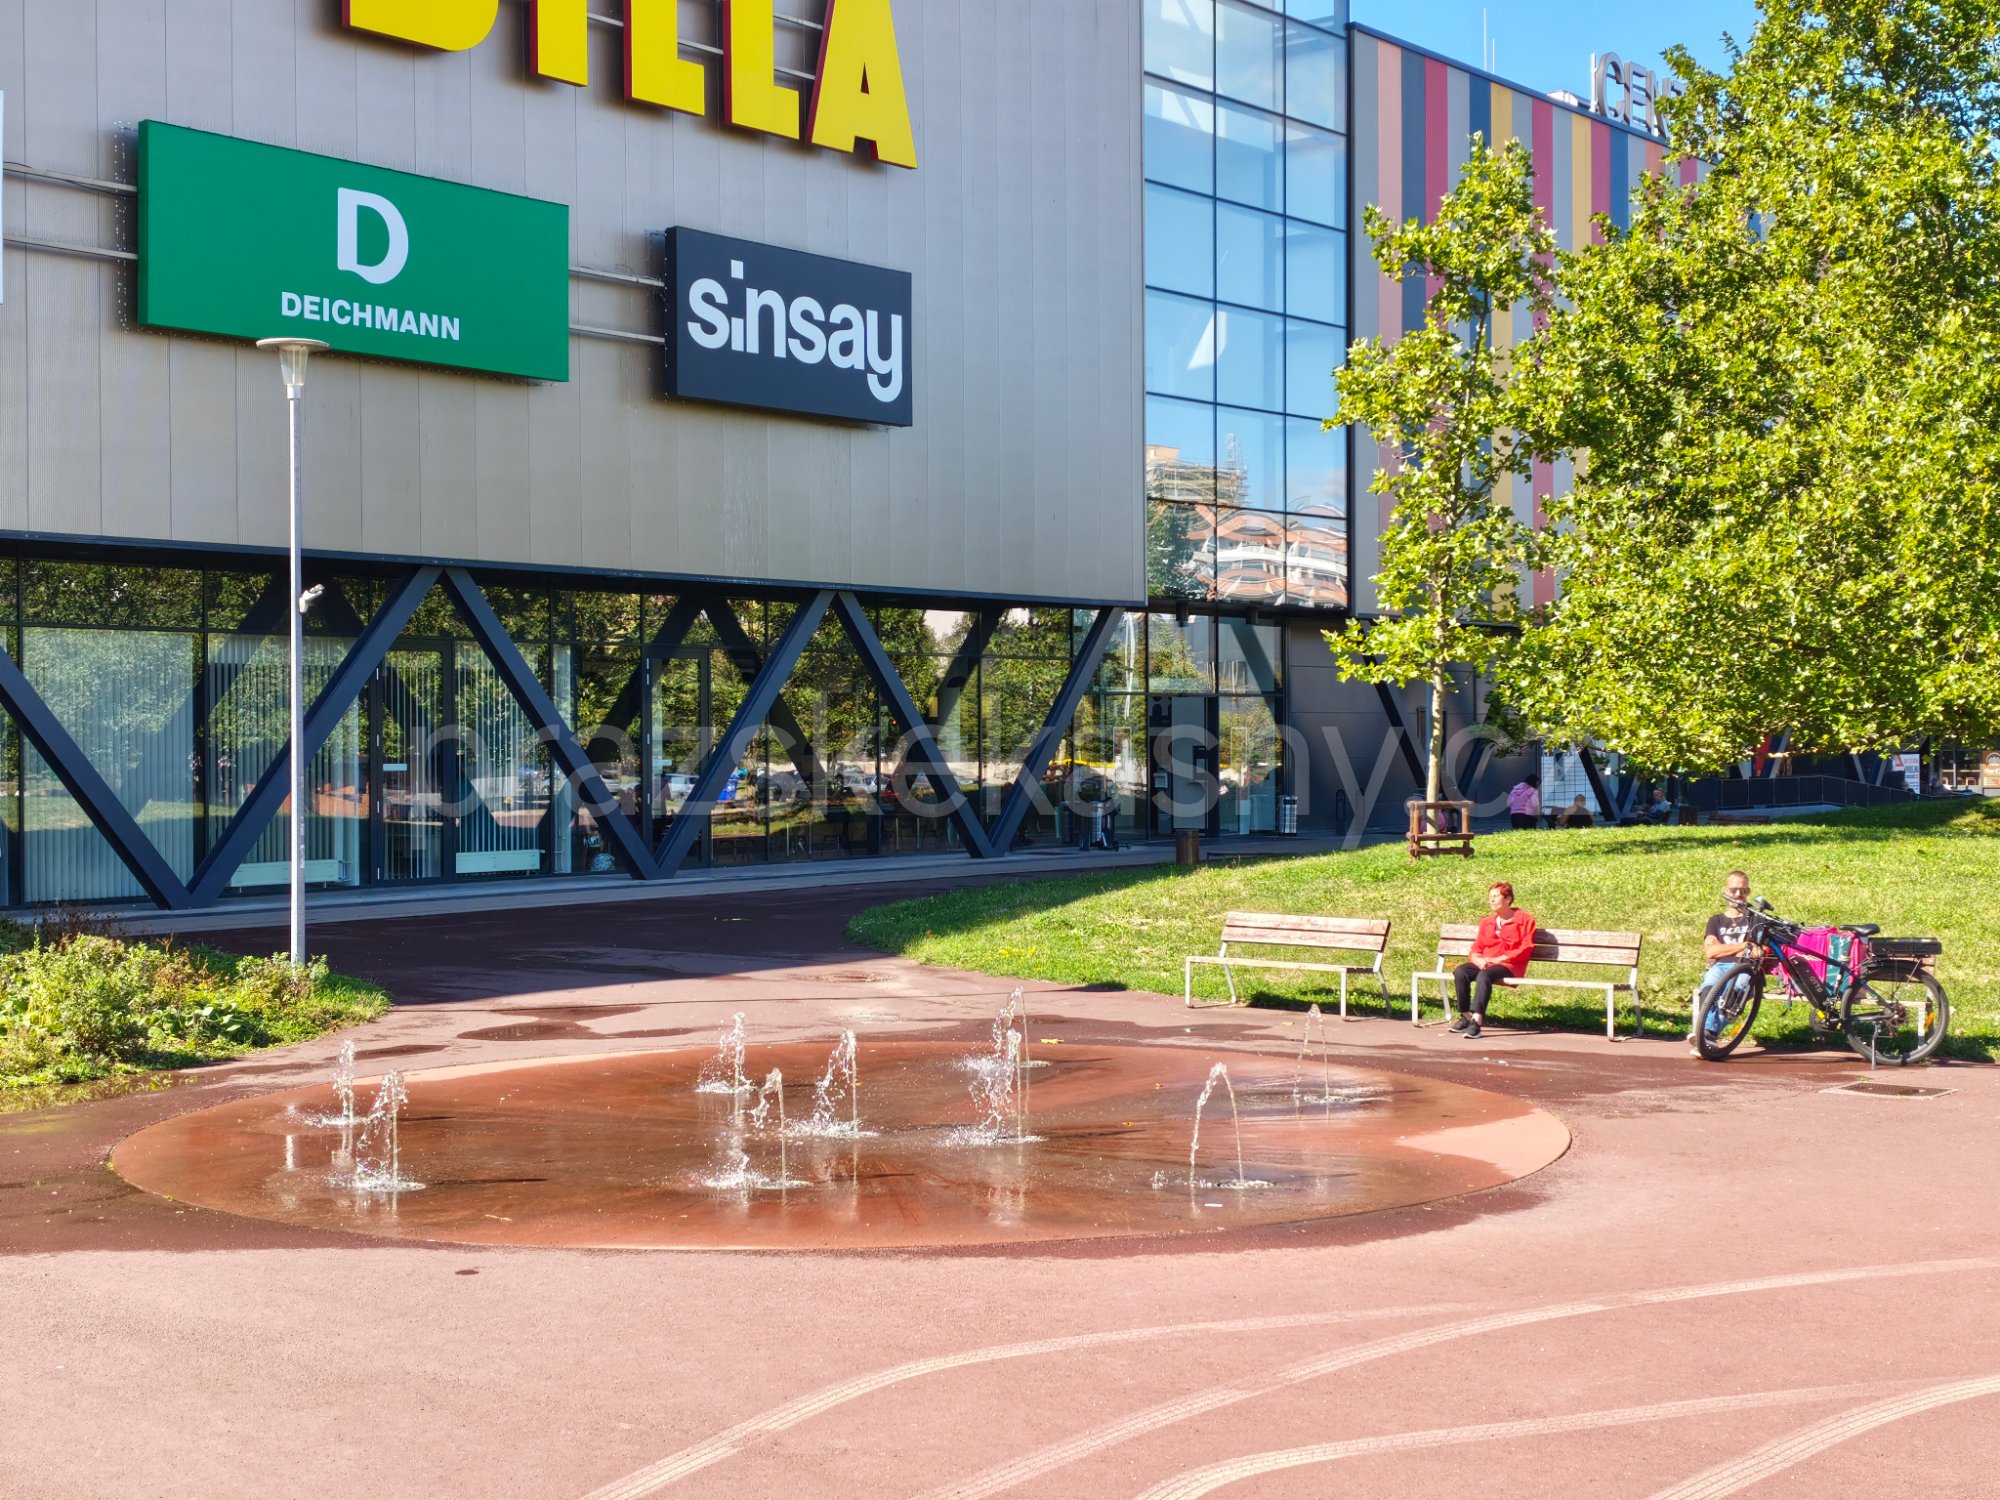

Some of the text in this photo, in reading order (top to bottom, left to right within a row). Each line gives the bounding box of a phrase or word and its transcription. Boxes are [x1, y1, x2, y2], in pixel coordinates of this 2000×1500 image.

[342, 0, 918, 169] LLA
[336, 186, 409, 284] D
[280, 291, 460, 341] DEICHMANN
[686, 259, 903, 403] sinsay
